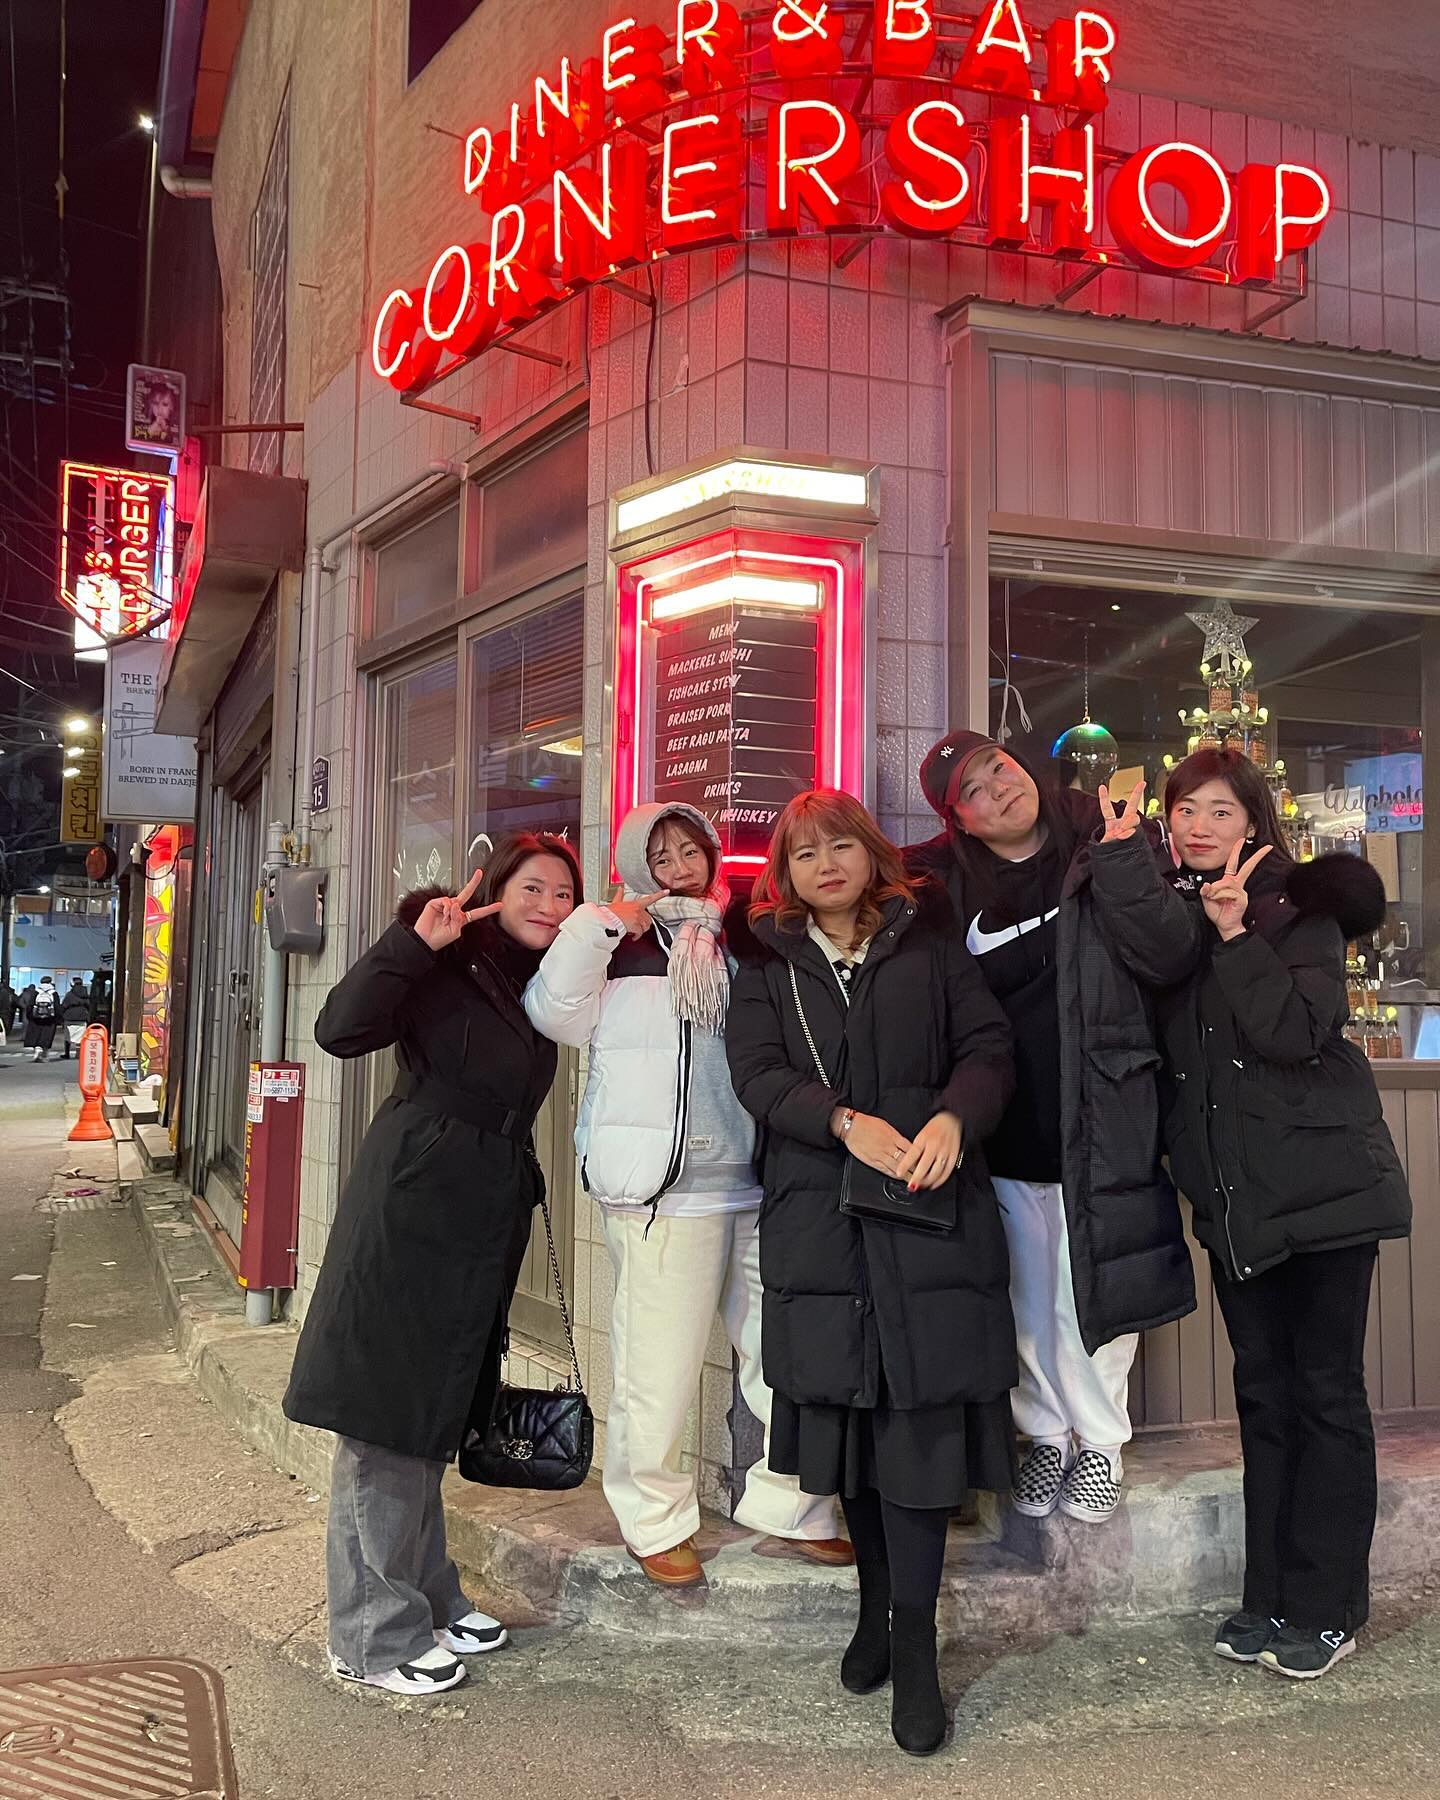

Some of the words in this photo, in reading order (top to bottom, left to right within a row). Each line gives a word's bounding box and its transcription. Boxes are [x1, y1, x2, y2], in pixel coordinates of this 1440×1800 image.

[463, 0, 720, 195] DINER
[884, 0, 1117, 84] BAR
[371, 98, 1333, 378] CORNERSHOP
[119, 478, 151, 614] BURGER
[708, 620, 740, 641] MENU
[667, 652, 717, 677] MACKEREL
[121, 672, 152, 686] THE
[667, 679, 711, 702] FISHCAKE
[711, 673, 742, 693] STEW
[667, 707, 706, 727] BRAISED
[705, 702, 732, 719] PORK
[666, 735, 689, 752] BEEF
[688, 730, 716, 748] RAGU
[129, 765, 155, 774] BORN
[156, 767, 167, 775] IN
[665, 758, 708, 778] LASAGNA
[118, 775, 157, 784] BREWED
[159, 777, 169, 785] IN
[703, 781, 742, 799] DRINKS
[313, 784, 323, 806] 15
[720, 807, 778, 824] WHISKEY
